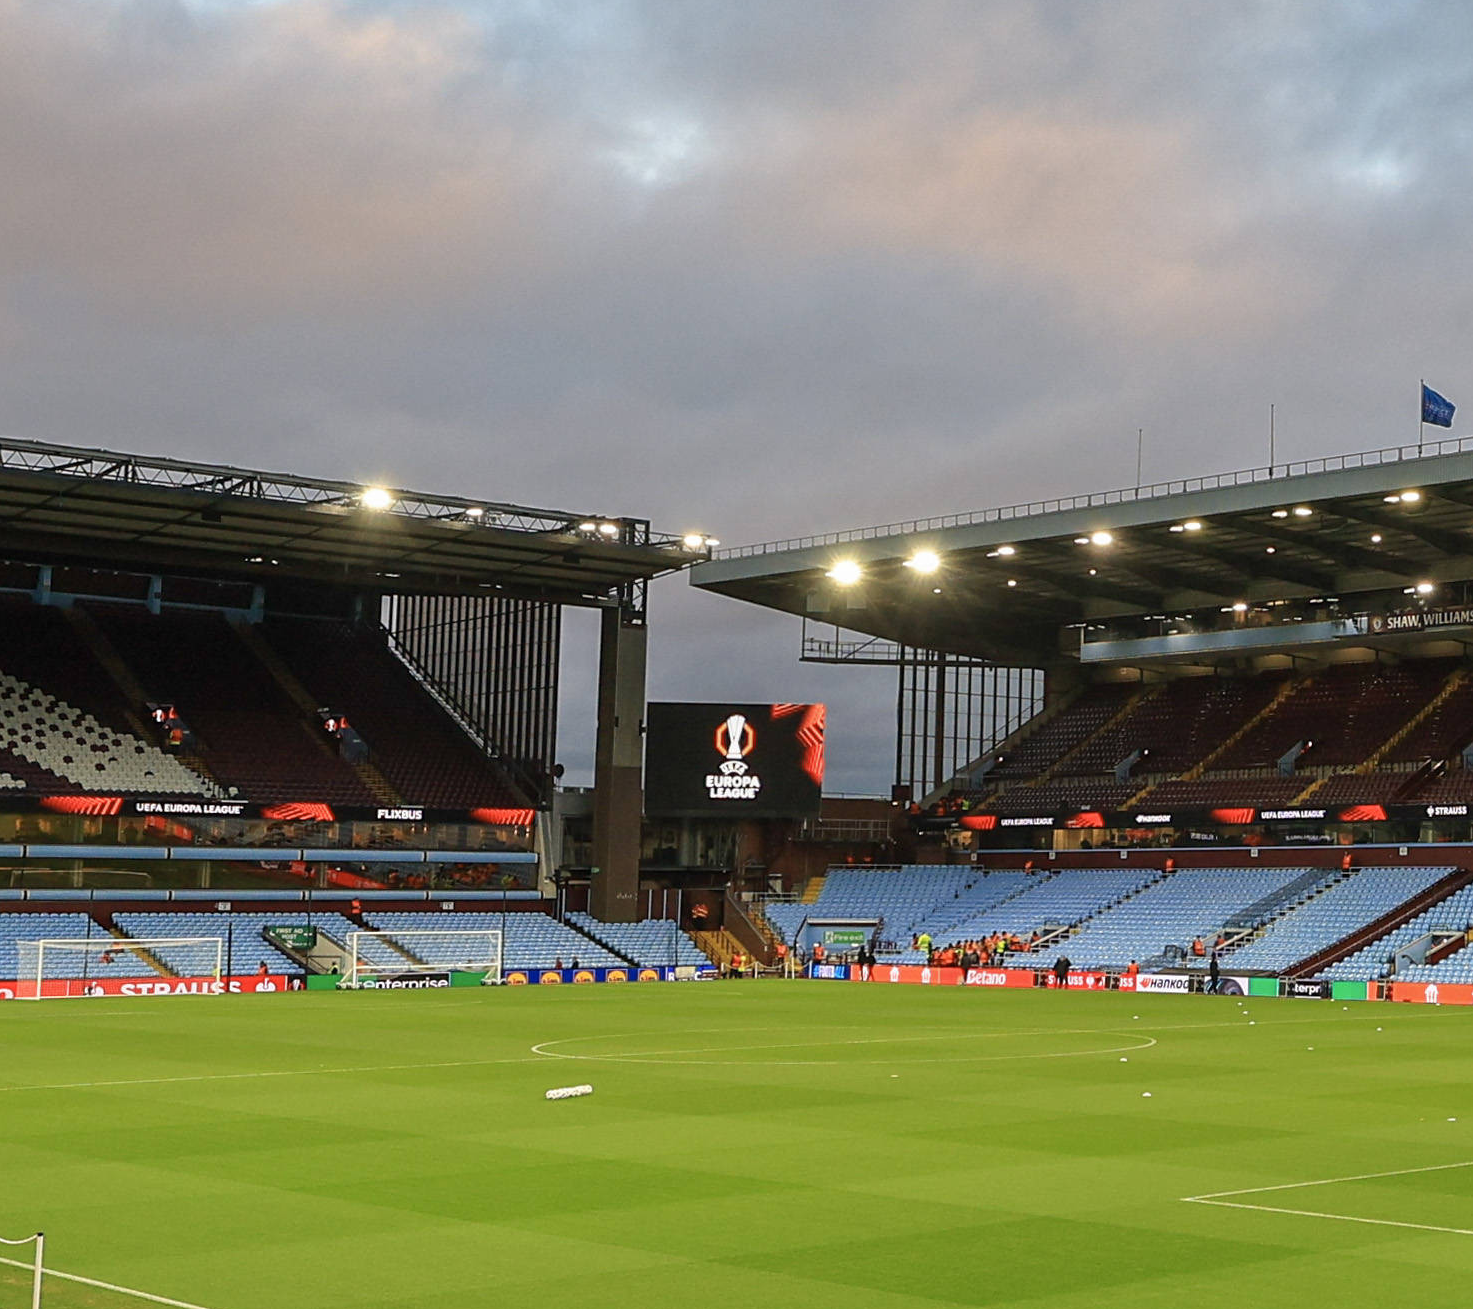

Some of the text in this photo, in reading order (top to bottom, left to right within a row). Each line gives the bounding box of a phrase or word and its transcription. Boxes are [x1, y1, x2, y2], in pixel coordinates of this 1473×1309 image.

[1387, 613, 1422, 630] SHAW,
[706, 775, 760, 787] EUROPA
[710, 787, 756, 799] LEAGUE
[136, 803, 241, 815] UEFA EUROPA LEAGUE
[377, 809, 423, 820] FLIXBUS
[1261, 811, 1277, 819] UEFA
[1278, 810, 1300, 819] EUROPA
[1435, 806, 1466, 815] STRAUSS
[966, 969, 1006, 985] Betano
